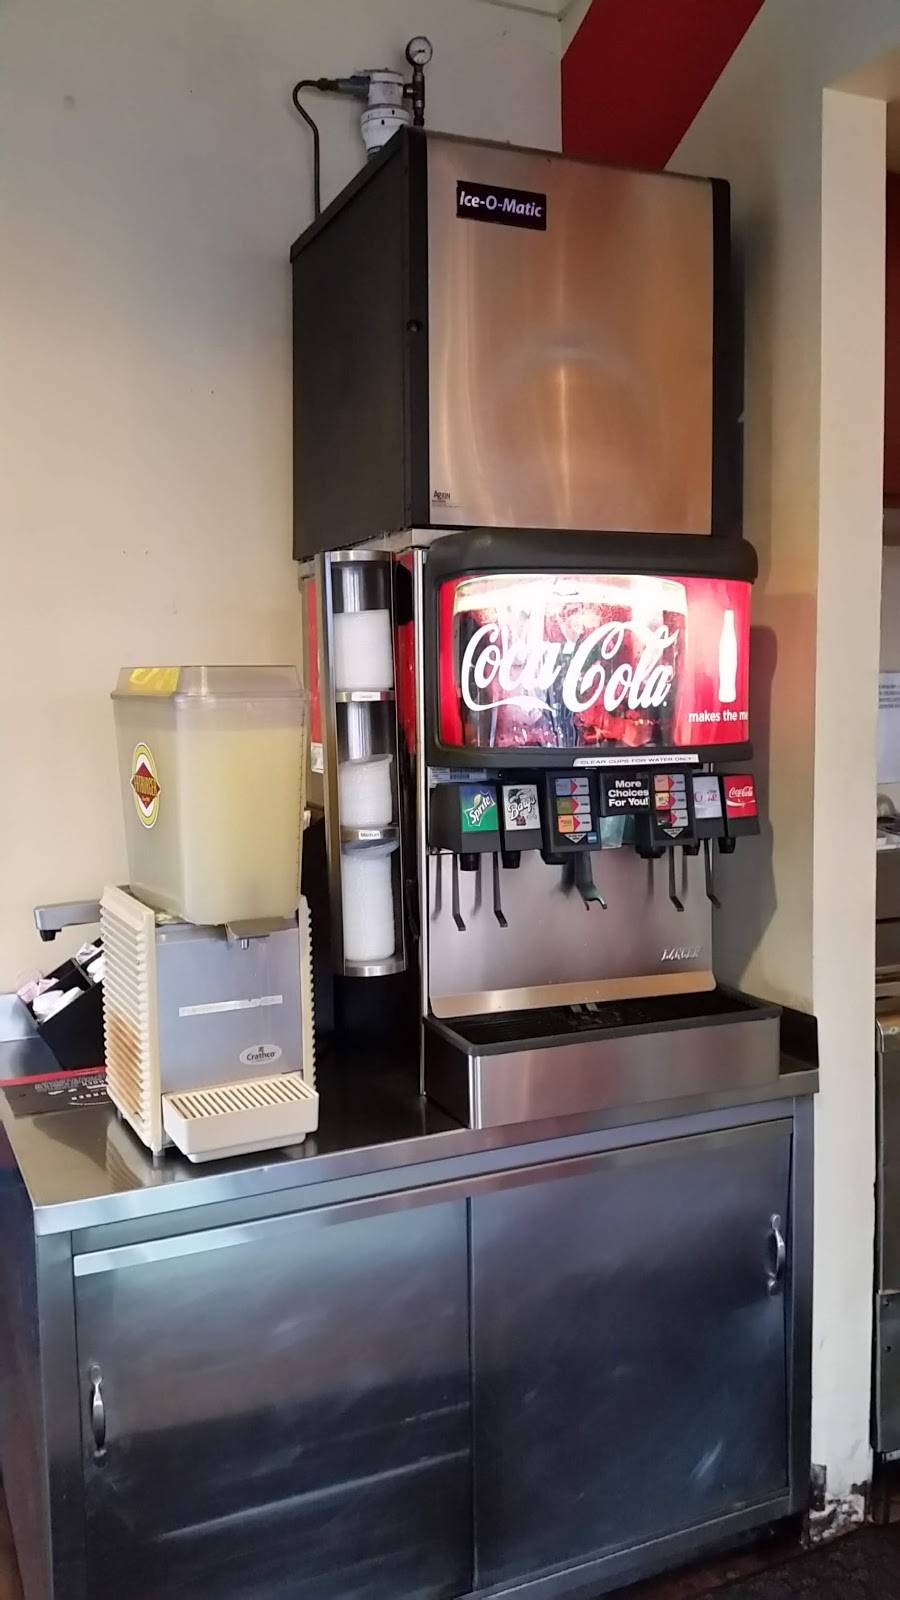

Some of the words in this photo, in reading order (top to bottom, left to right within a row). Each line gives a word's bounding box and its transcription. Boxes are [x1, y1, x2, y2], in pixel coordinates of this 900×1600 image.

[459, 190, 542, 218] Ice-O-Matic
[688, 709, 721, 723] makes
[722, 708, 738, 722] the
[615, 780, 642, 788] More
[608, 789, 649, 798] Choices
[608, 798, 627, 807] For
[627, 797, 649, 806] You!
[469, 795, 491, 825] Sprite
[246, 1051, 276, 1062] Crathco
